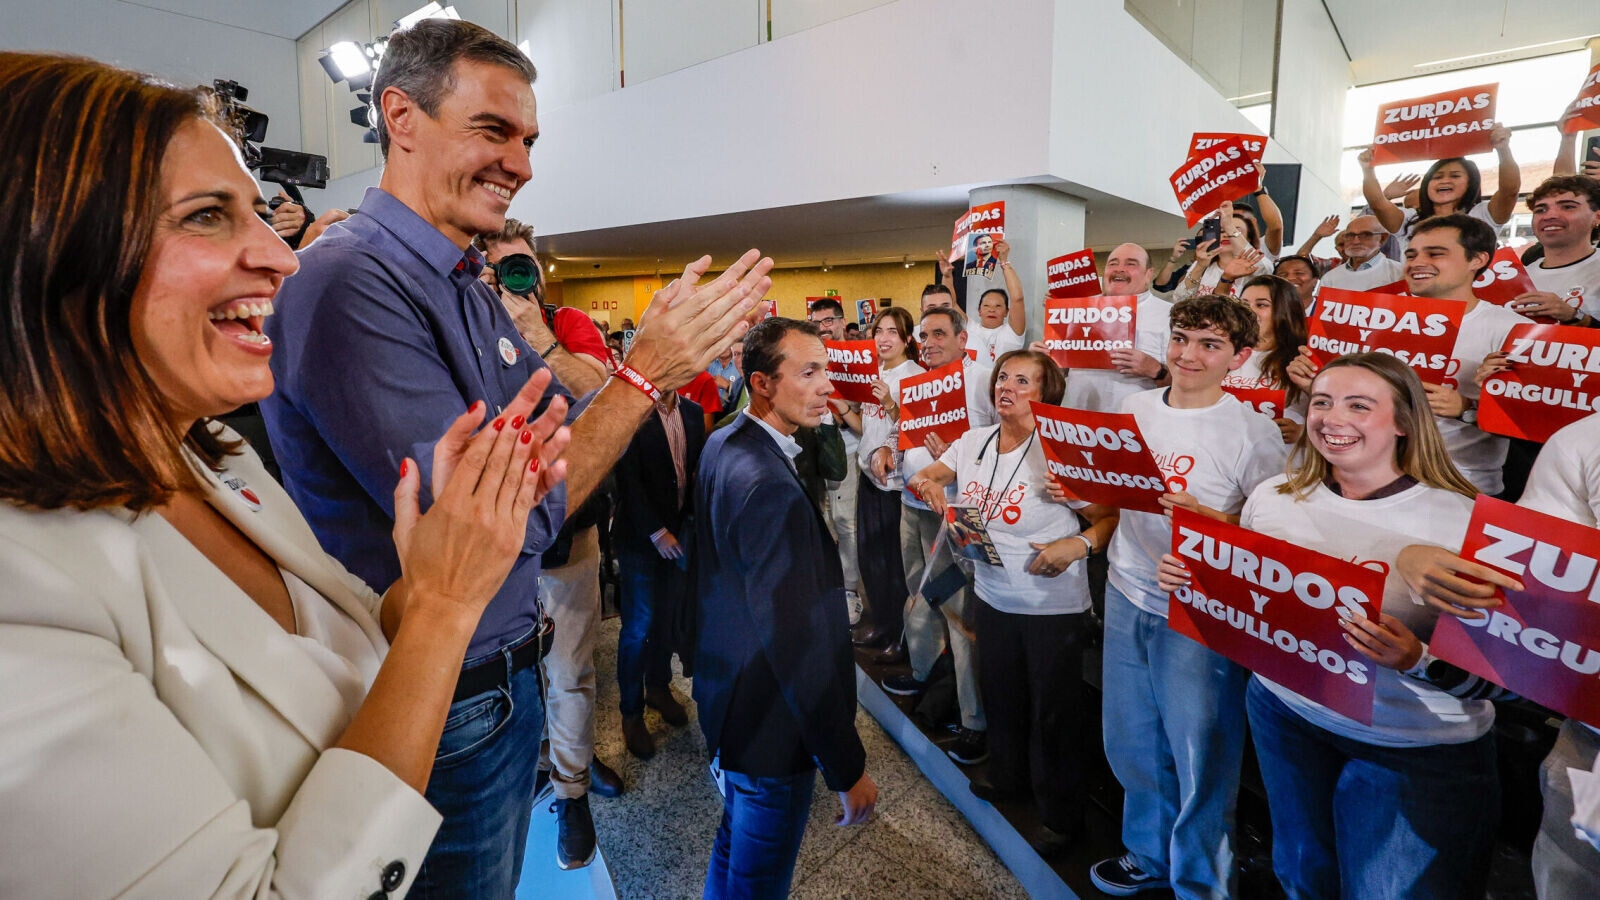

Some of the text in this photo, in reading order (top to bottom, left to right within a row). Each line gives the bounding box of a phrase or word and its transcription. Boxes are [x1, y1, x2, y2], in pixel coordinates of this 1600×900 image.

[1384, 93, 1490, 123] ZURDAS
[1374, 118, 1495, 144] ORGULLOSAS
[1428, 117, 1439, 126] Y
[1174, 146, 1241, 192] ZURDAS
[1201, 173, 1209, 182] Y
[1181, 163, 1255, 211] ORGULLOSAS
[1048, 256, 1091, 276] ZURDAS
[1048, 272, 1098, 290] ORGULLOSAS
[1047, 306, 1132, 324] ZURDOS
[1319, 300, 1449, 337] ZURDAS
[1081, 326, 1092, 337] Y
[1358, 329, 1372, 342] Y
[1045, 339, 1133, 351] ORGULLOSOS
[622, 367, 645, 386] ZURDO
[825, 371, 878, 384] RGULLOSAS
[842, 363, 848, 372] Y
[902, 371, 962, 404] ZURDOS
[1571, 372, 1589, 388] Y
[929, 400, 938, 412] Y
[900, 407, 966, 432] ORGULLOSOS
[1035, 414, 1142, 453] ZURDOS
[1080, 450, 1094, 466] Y
[1047, 459, 1166, 492] ORGULLOSOS
[1177, 525, 1370, 622] ZURDOS
[1473, 522, 1600, 604] ZU
[1249, 590, 1271, 615] Y
[1173, 585, 1369, 685] ORGULLOSOS
[1453, 603, 1600, 676] ORGU
